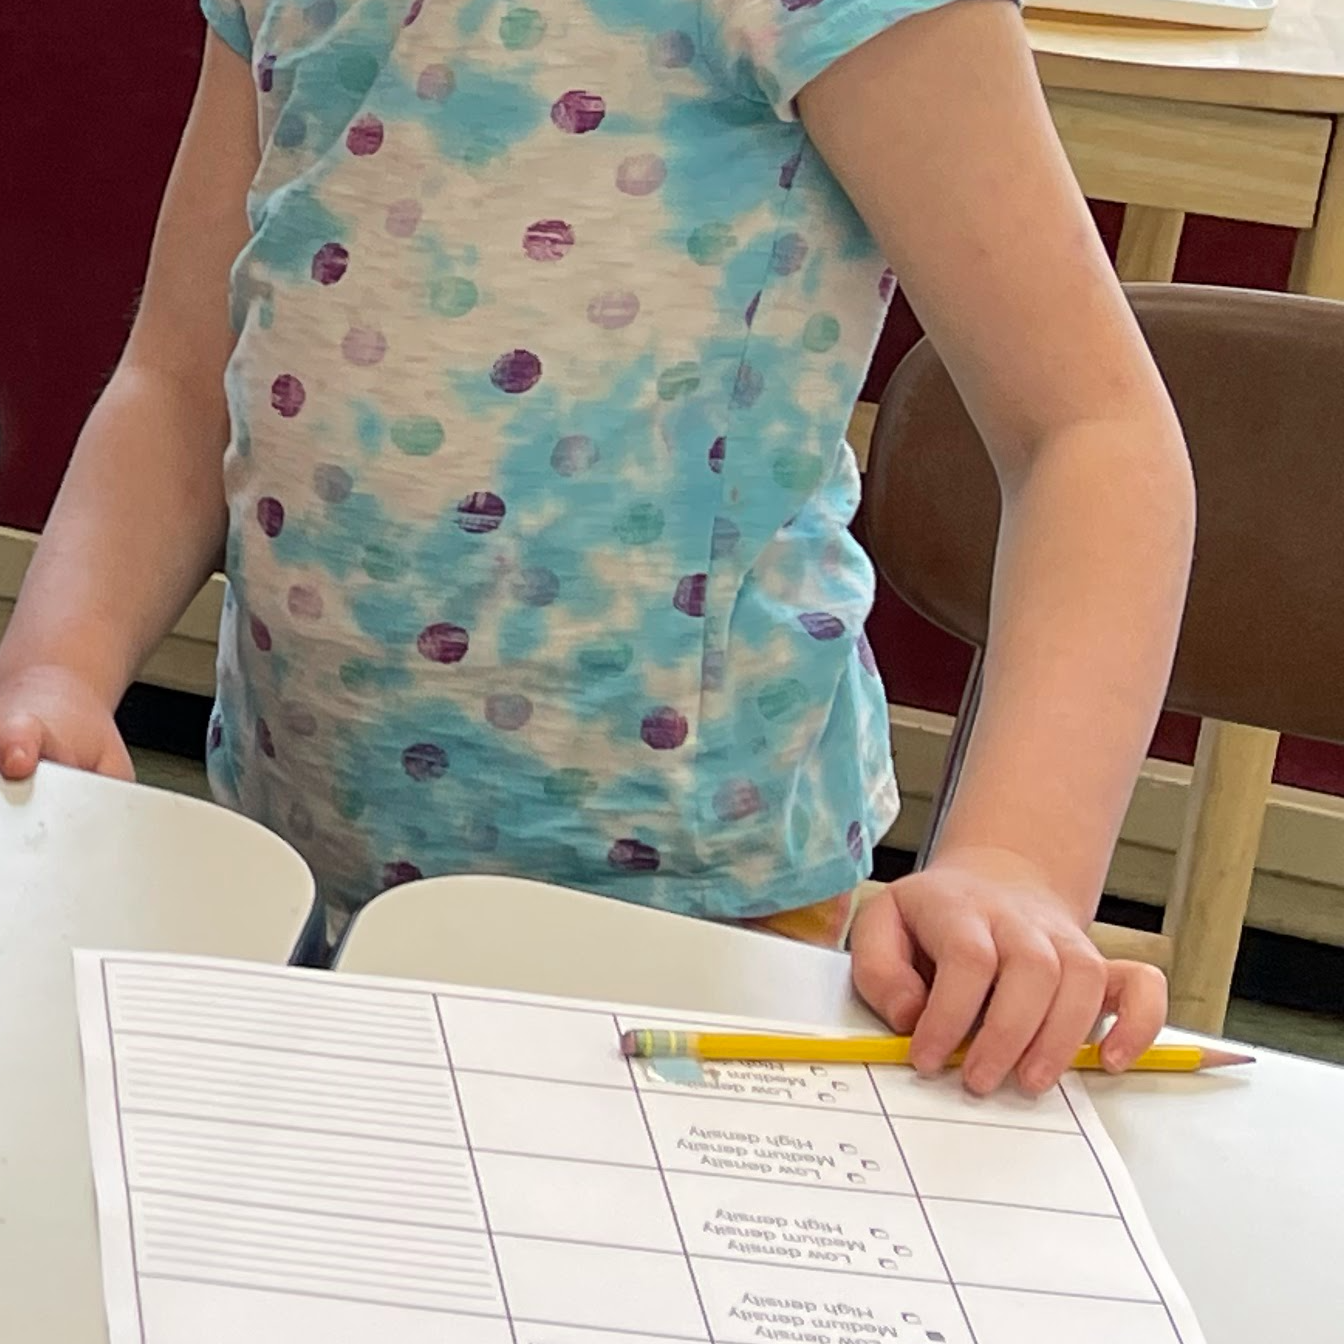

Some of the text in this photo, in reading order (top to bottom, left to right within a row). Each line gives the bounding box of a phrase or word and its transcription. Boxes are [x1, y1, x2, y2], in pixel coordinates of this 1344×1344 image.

[750, 1084, 793, 1100] Low
[688, 1125, 815, 1151] High density
[676, 1138, 837, 1168] Medium density
[700, 1153, 822, 1181] Low density
[715, 1207, 844, 1236] High density
[702, 1219, 867, 1253] Medium density
[727, 1238, 852, 1265] Low density
[741, 1291, 875, 1320] High density
[727, 1305, 899, 1339] Medium density
[755, 1324, 832, 1344] density
